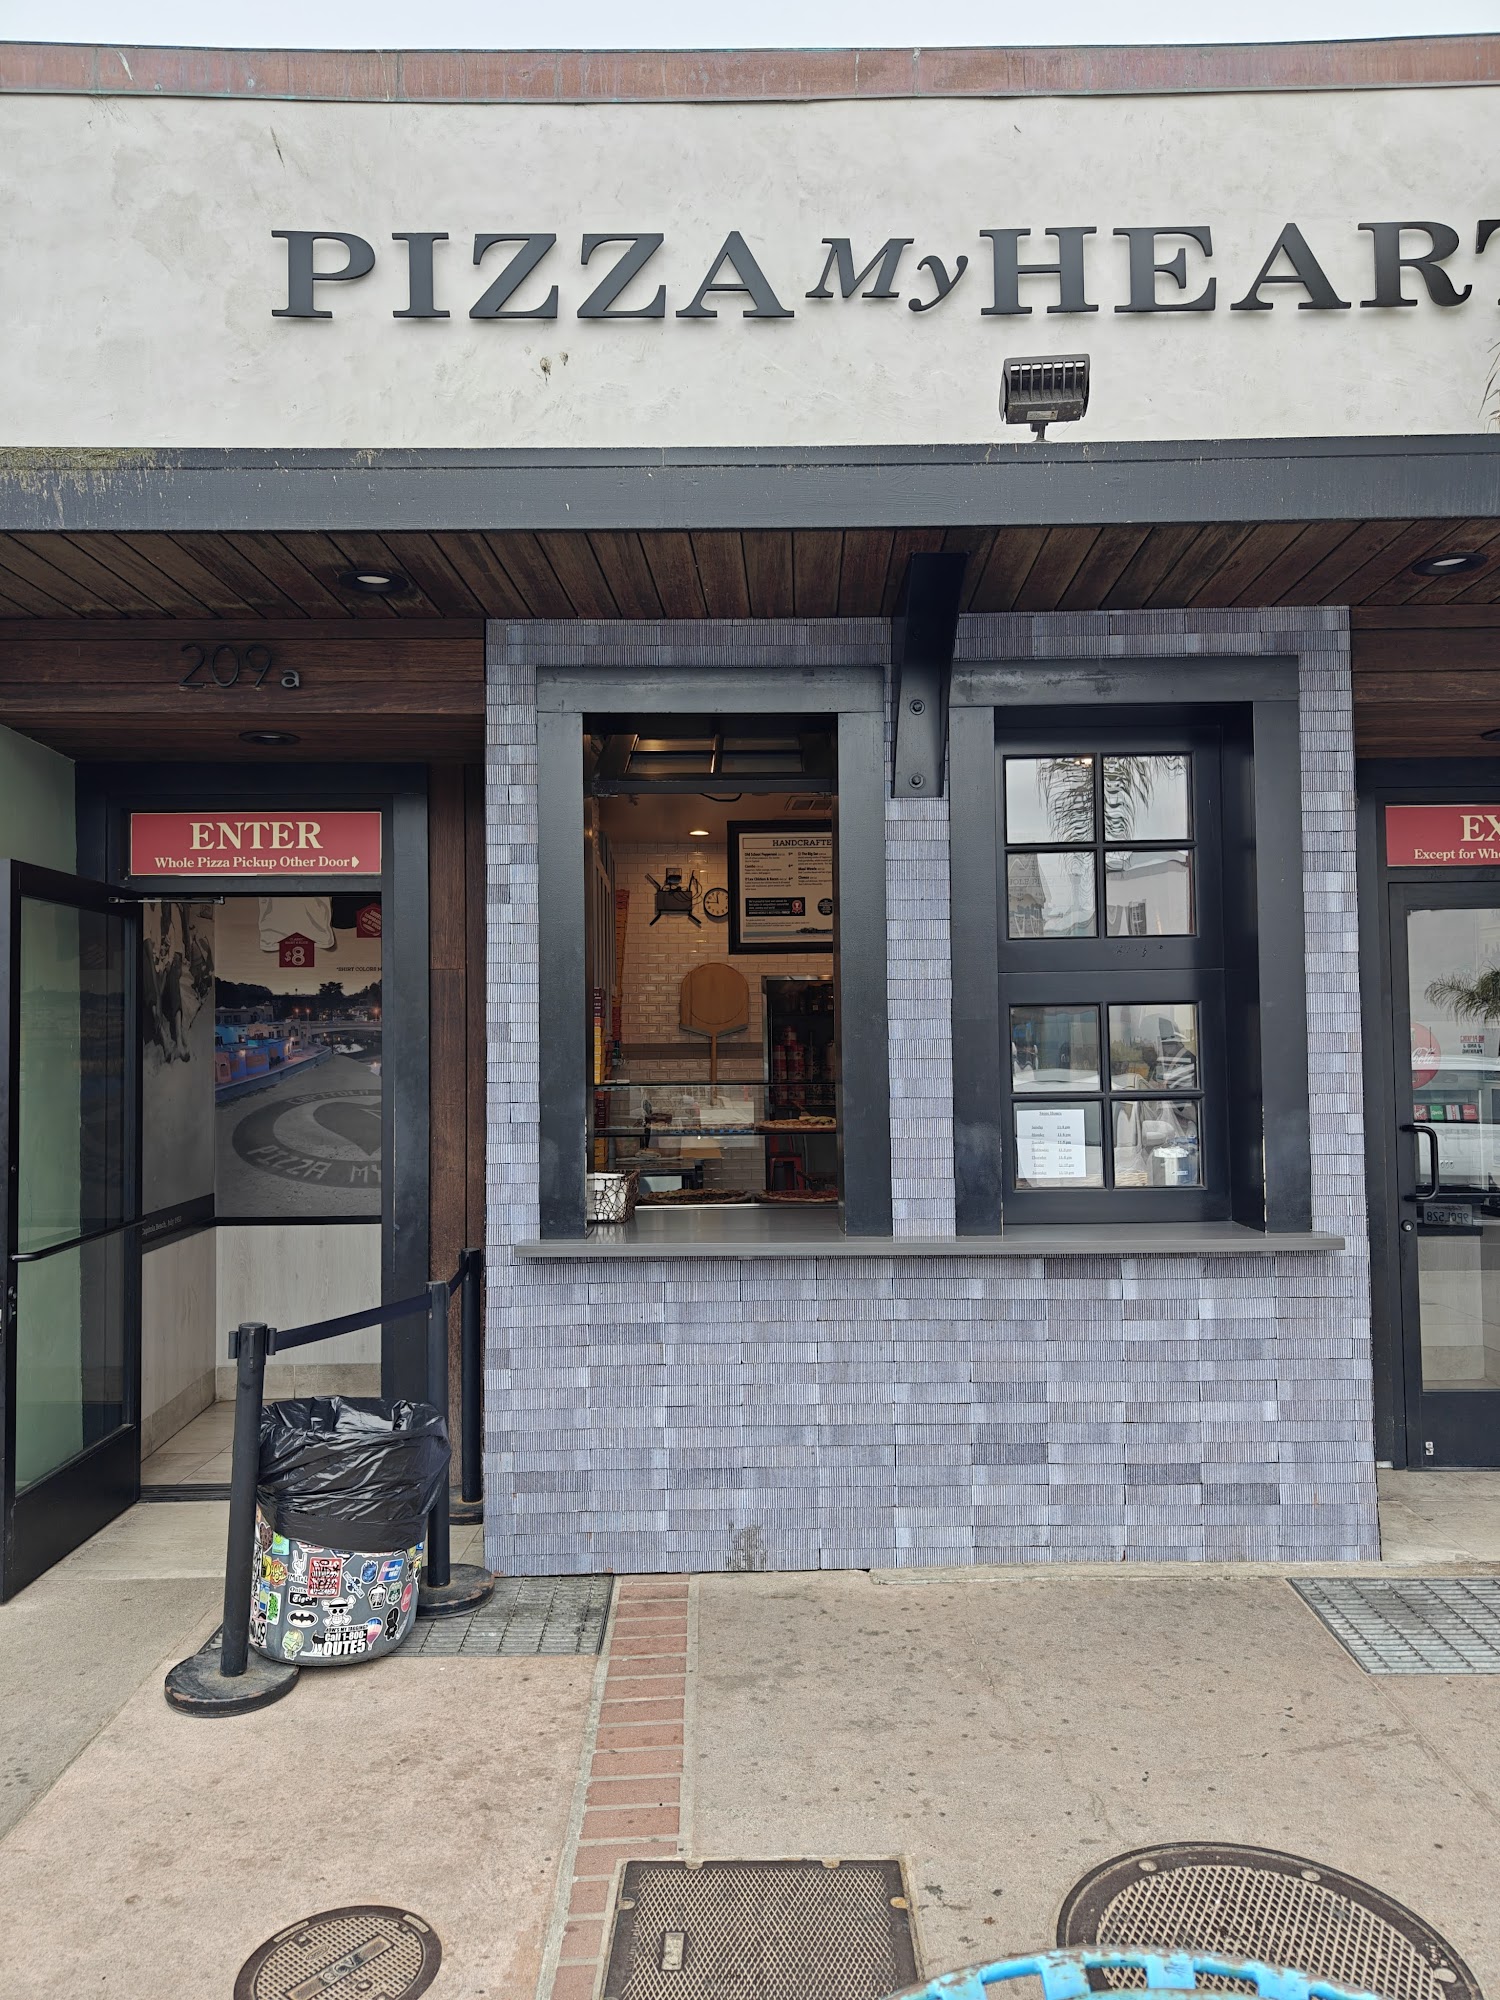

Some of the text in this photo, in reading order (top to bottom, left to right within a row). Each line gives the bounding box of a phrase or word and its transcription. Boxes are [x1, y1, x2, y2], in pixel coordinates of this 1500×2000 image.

[271, 219, 1500, 319] PIZZA My HEAR
[189, 821, 323, 850] ENTER
[154, 854, 350, 870] Whole Pizza Pickup Other Door
[1413, 848, 1500, 861] Except for Wh
[284, 946, 305, 965] $8
[247, 1144, 331, 1181] PIZZA
